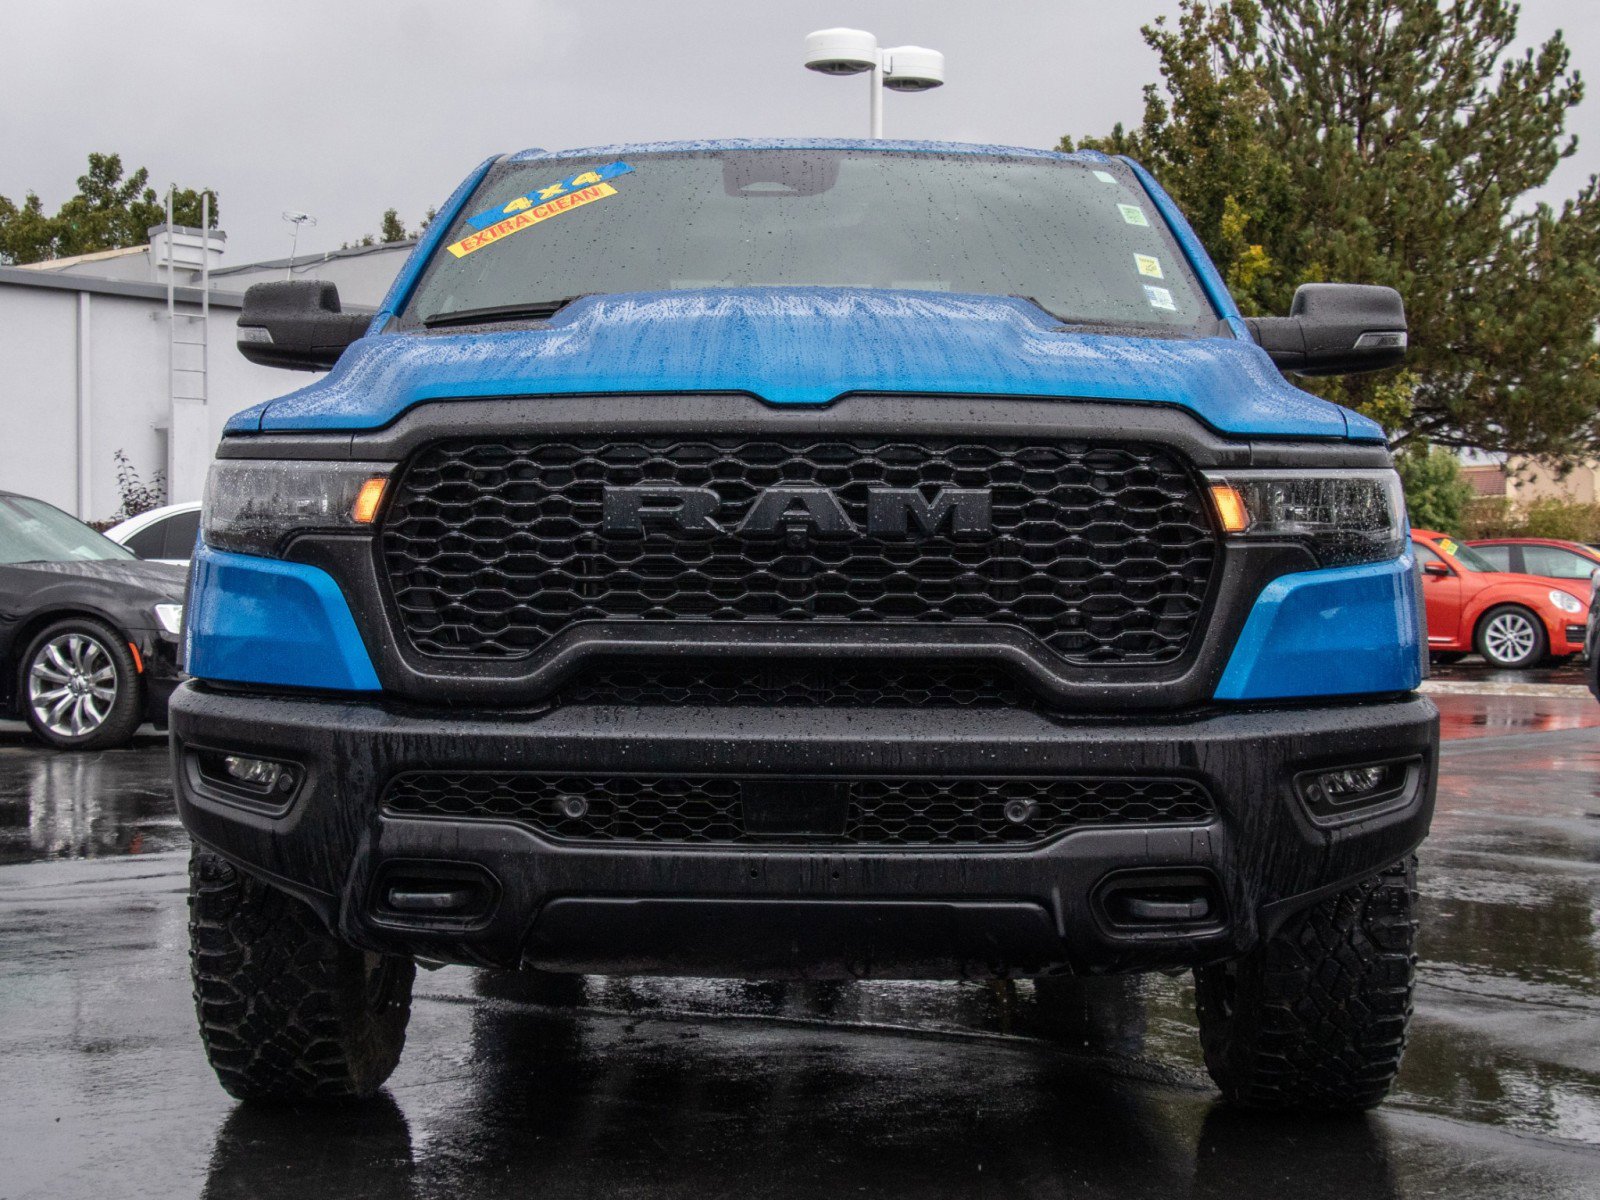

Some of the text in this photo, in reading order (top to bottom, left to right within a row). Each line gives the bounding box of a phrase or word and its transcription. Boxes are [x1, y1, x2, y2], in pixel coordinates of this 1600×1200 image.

[460, 187, 600, 252] EXTRA CLEAN
[602, 485, 993, 539] RAM
